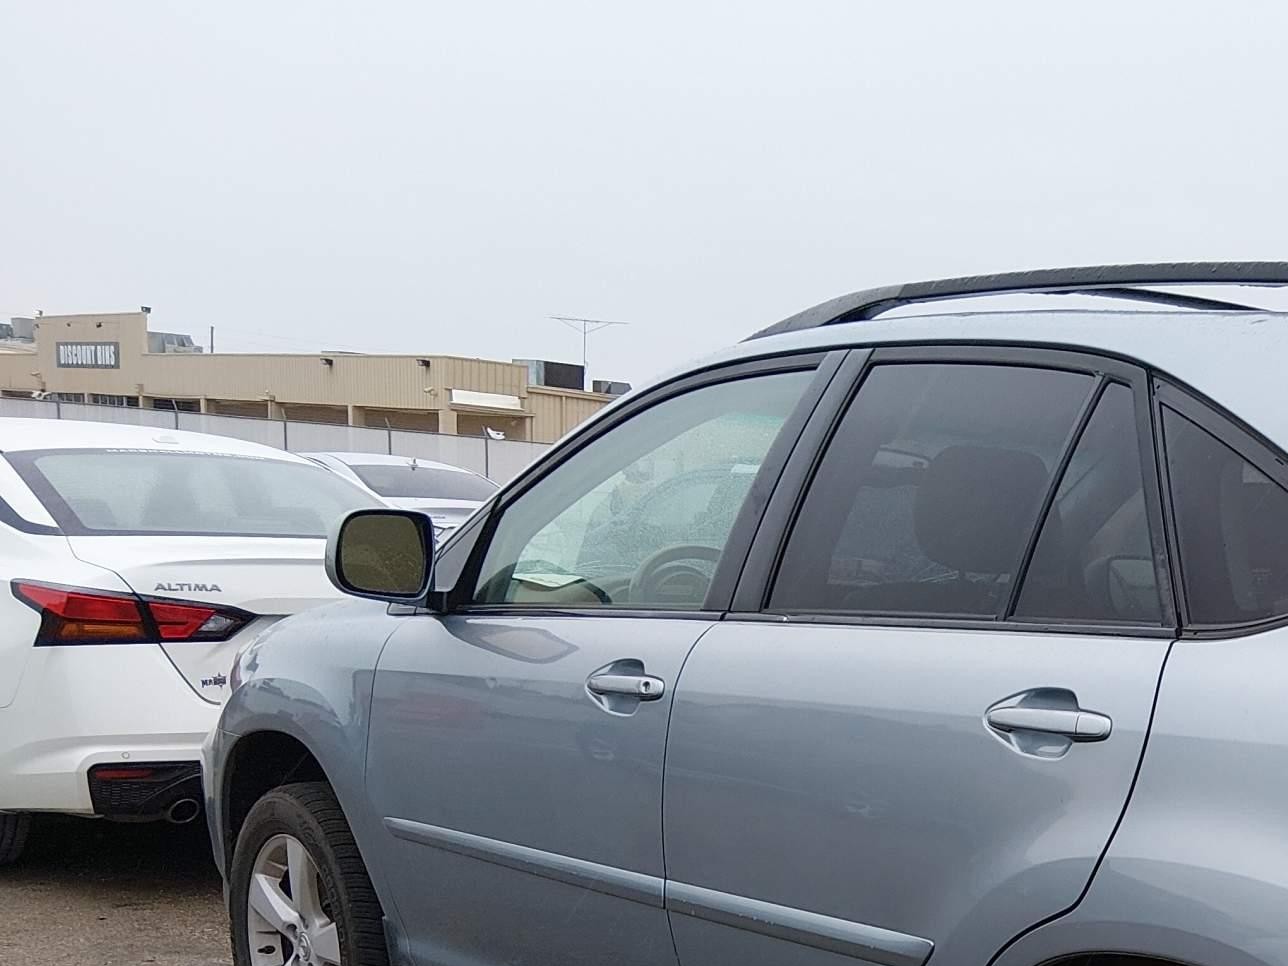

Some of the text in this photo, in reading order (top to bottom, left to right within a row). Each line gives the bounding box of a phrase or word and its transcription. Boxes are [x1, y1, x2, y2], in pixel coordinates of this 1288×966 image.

[60, 344, 115, 365] DISCOUNT BINS
[154, 582, 222, 592] ALTIMA
